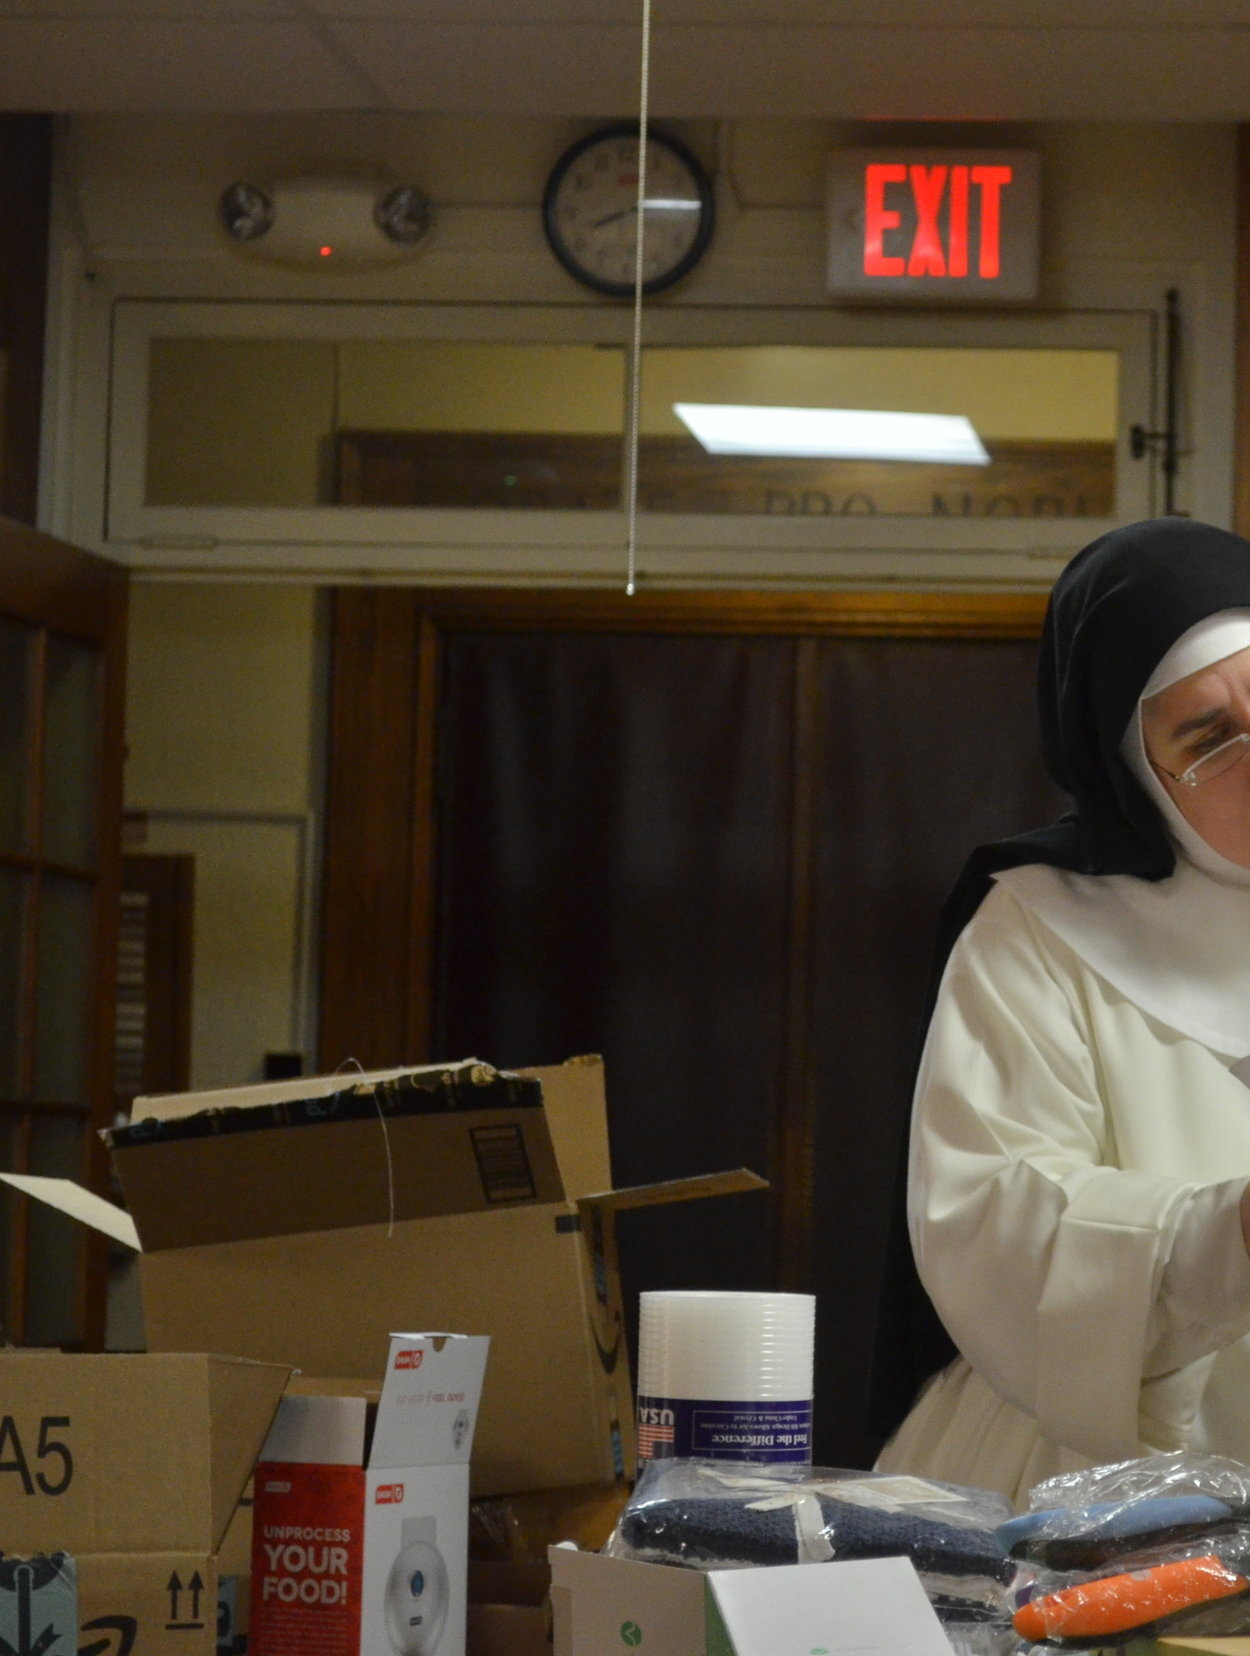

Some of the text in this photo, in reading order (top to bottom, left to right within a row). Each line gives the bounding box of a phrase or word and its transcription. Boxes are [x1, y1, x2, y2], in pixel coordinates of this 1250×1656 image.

[863, 163, 1013, 279] EXIT
[712, 1434, 774, 1446] Difference
[776, 1434, 792, 1446] the
[263, 1525, 351, 1543] UNPROCESS
[263, 1543, 348, 1576] YOUR
[262, 1575, 348, 1606] FOOD!
